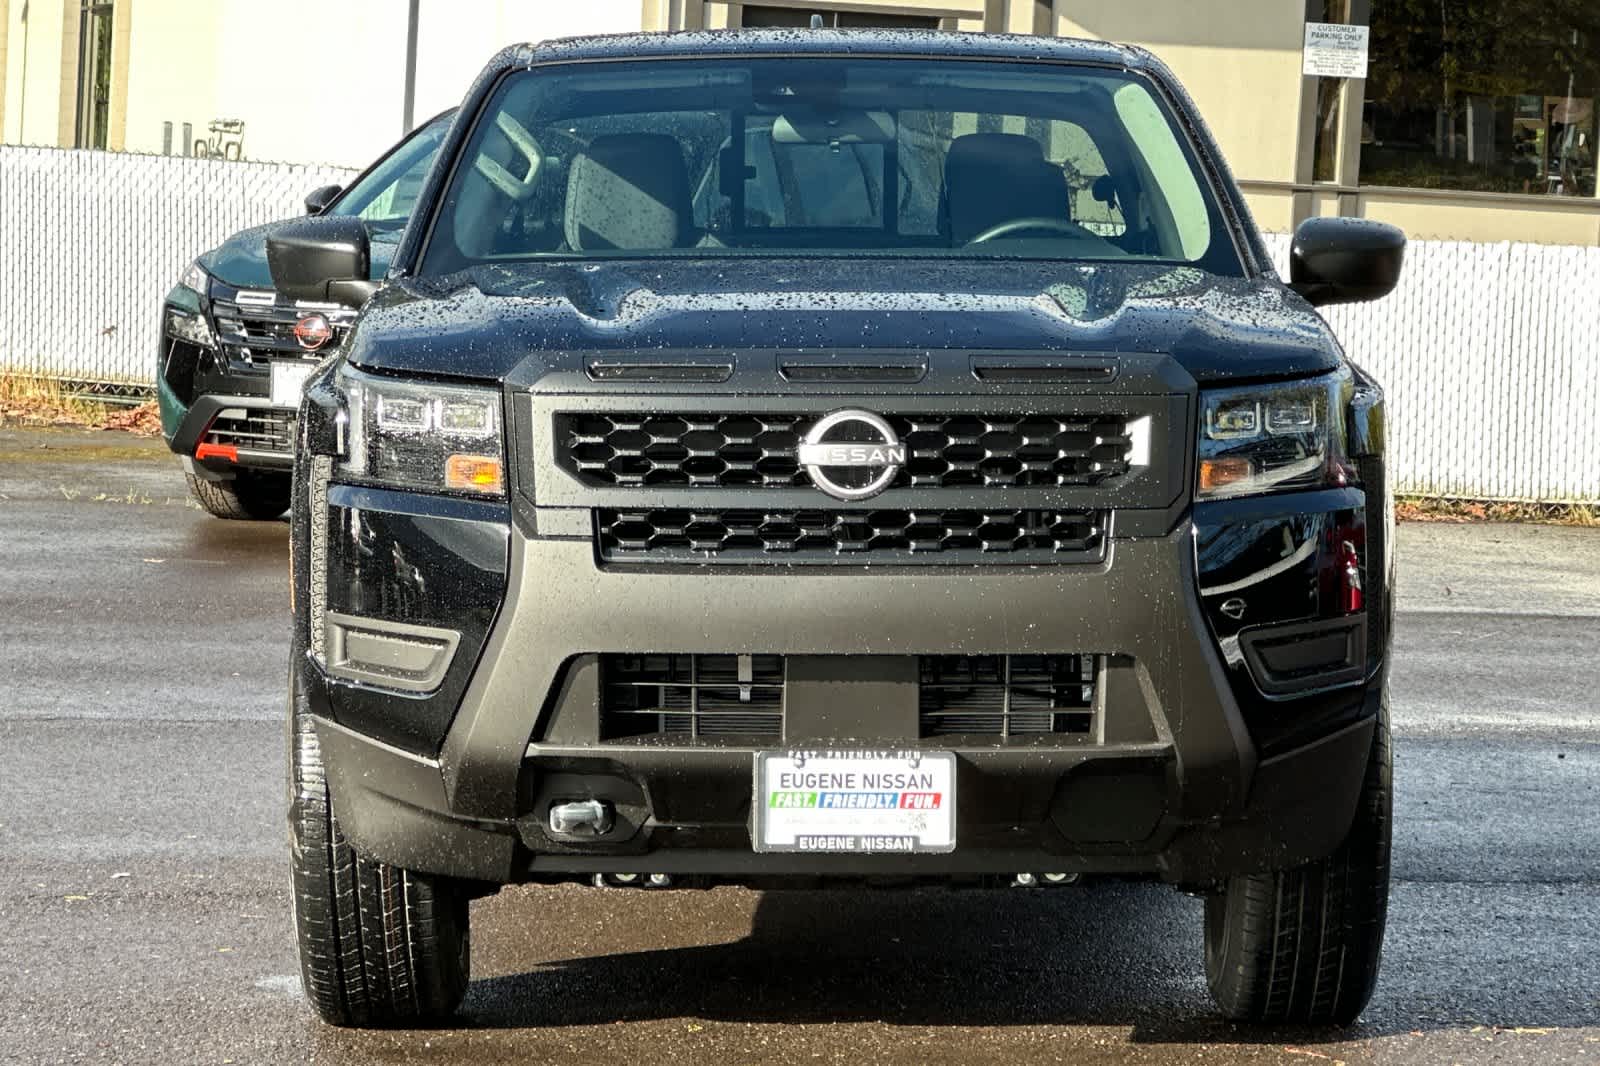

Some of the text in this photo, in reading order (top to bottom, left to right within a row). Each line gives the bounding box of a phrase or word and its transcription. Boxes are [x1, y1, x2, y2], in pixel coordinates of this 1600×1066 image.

[1311, 32, 1343, 40] PARKING
[1317, 25, 1357, 33] CUSTOMER
[806, 447, 906, 463] ISSAN
[780, 773, 933, 789] EUGENE NISSAN
[774, 793, 938, 809] FAST. FRIENDLY. FUN.
[799, 837, 913, 851] EUGENE NISSAN
